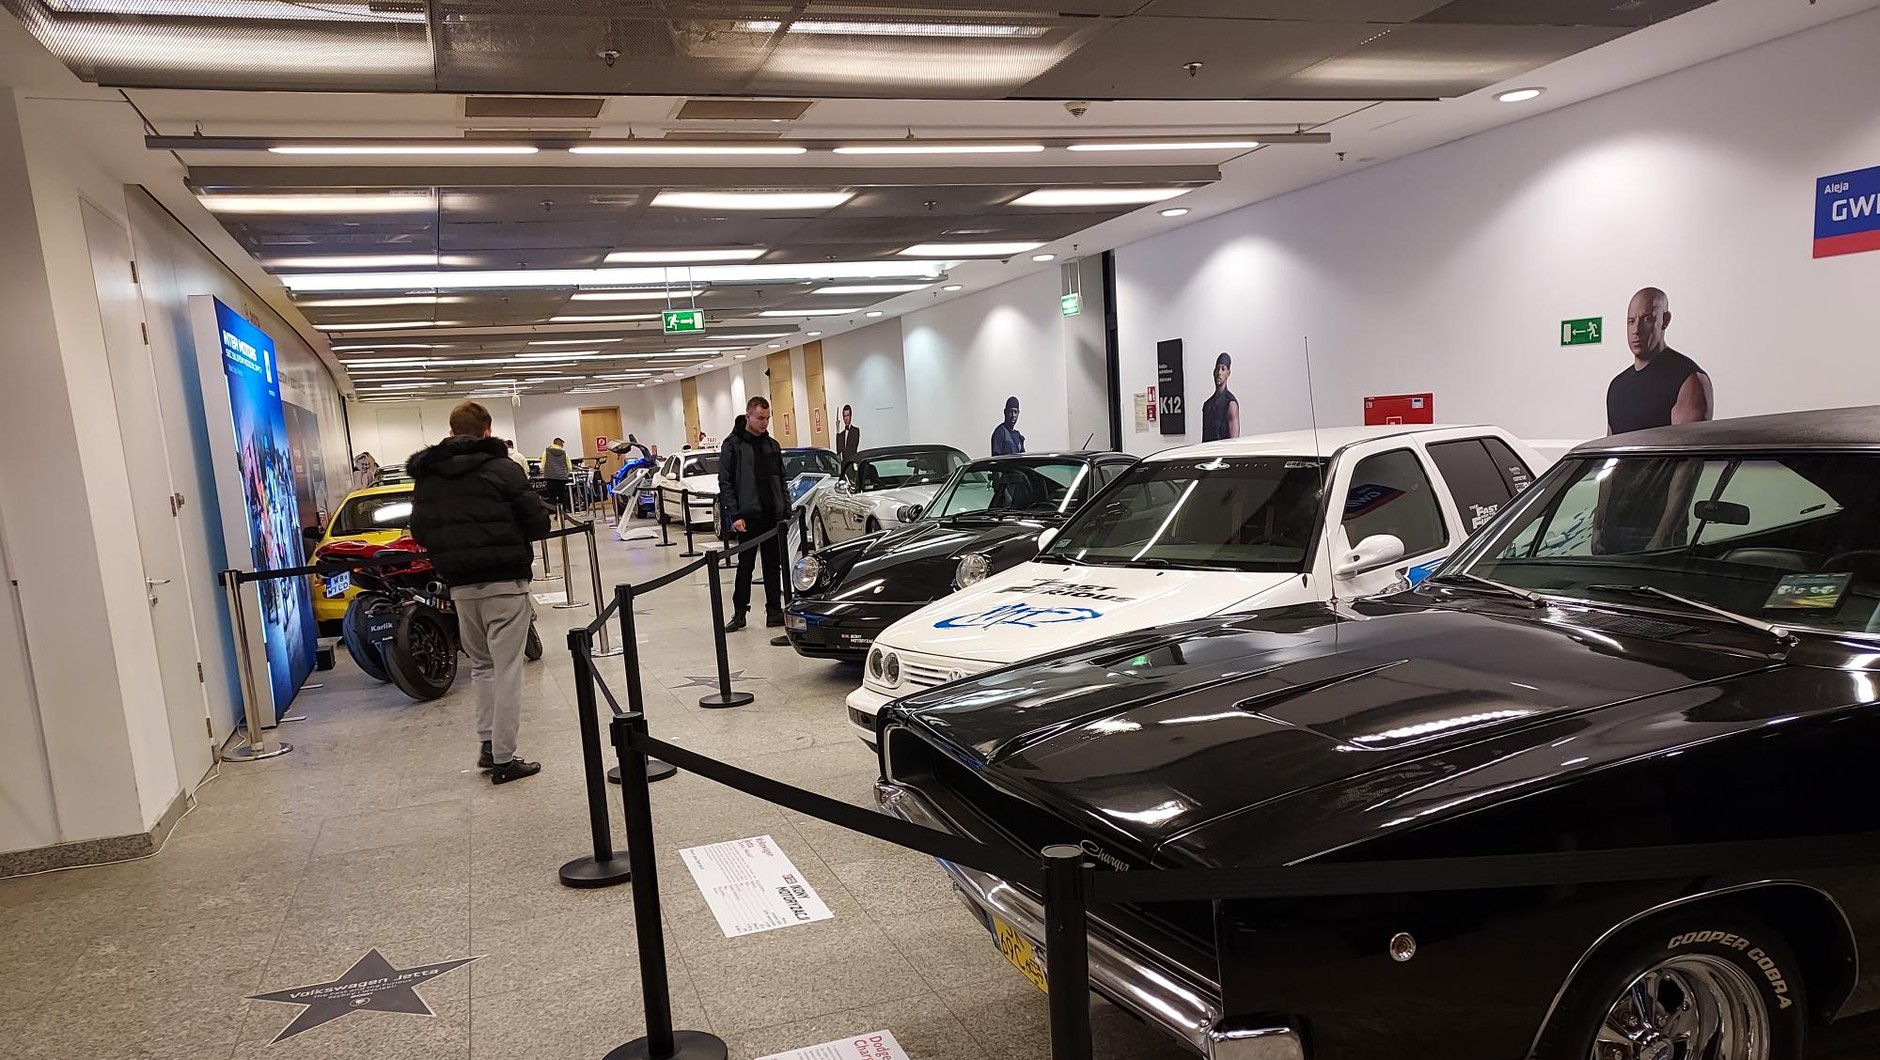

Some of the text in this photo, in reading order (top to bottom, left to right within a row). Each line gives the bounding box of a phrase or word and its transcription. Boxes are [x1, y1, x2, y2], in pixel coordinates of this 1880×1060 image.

[1824, 182, 1849, 194] Aleja
[1160, 396, 1182, 414] K12
[1476, 504, 1498, 517] FAST
[370, 622, 393, 633] Karlik
[1080, 839, 1130, 872] Charger
[789, 884, 811, 900] IKONY
[1667, 930, 1751, 951] COOPER
[289, 968, 439, 999] Volkswagen Jetta
[1747, 947, 1793, 1010] COBRA
[869, 1035, 891, 1060] Dodge
